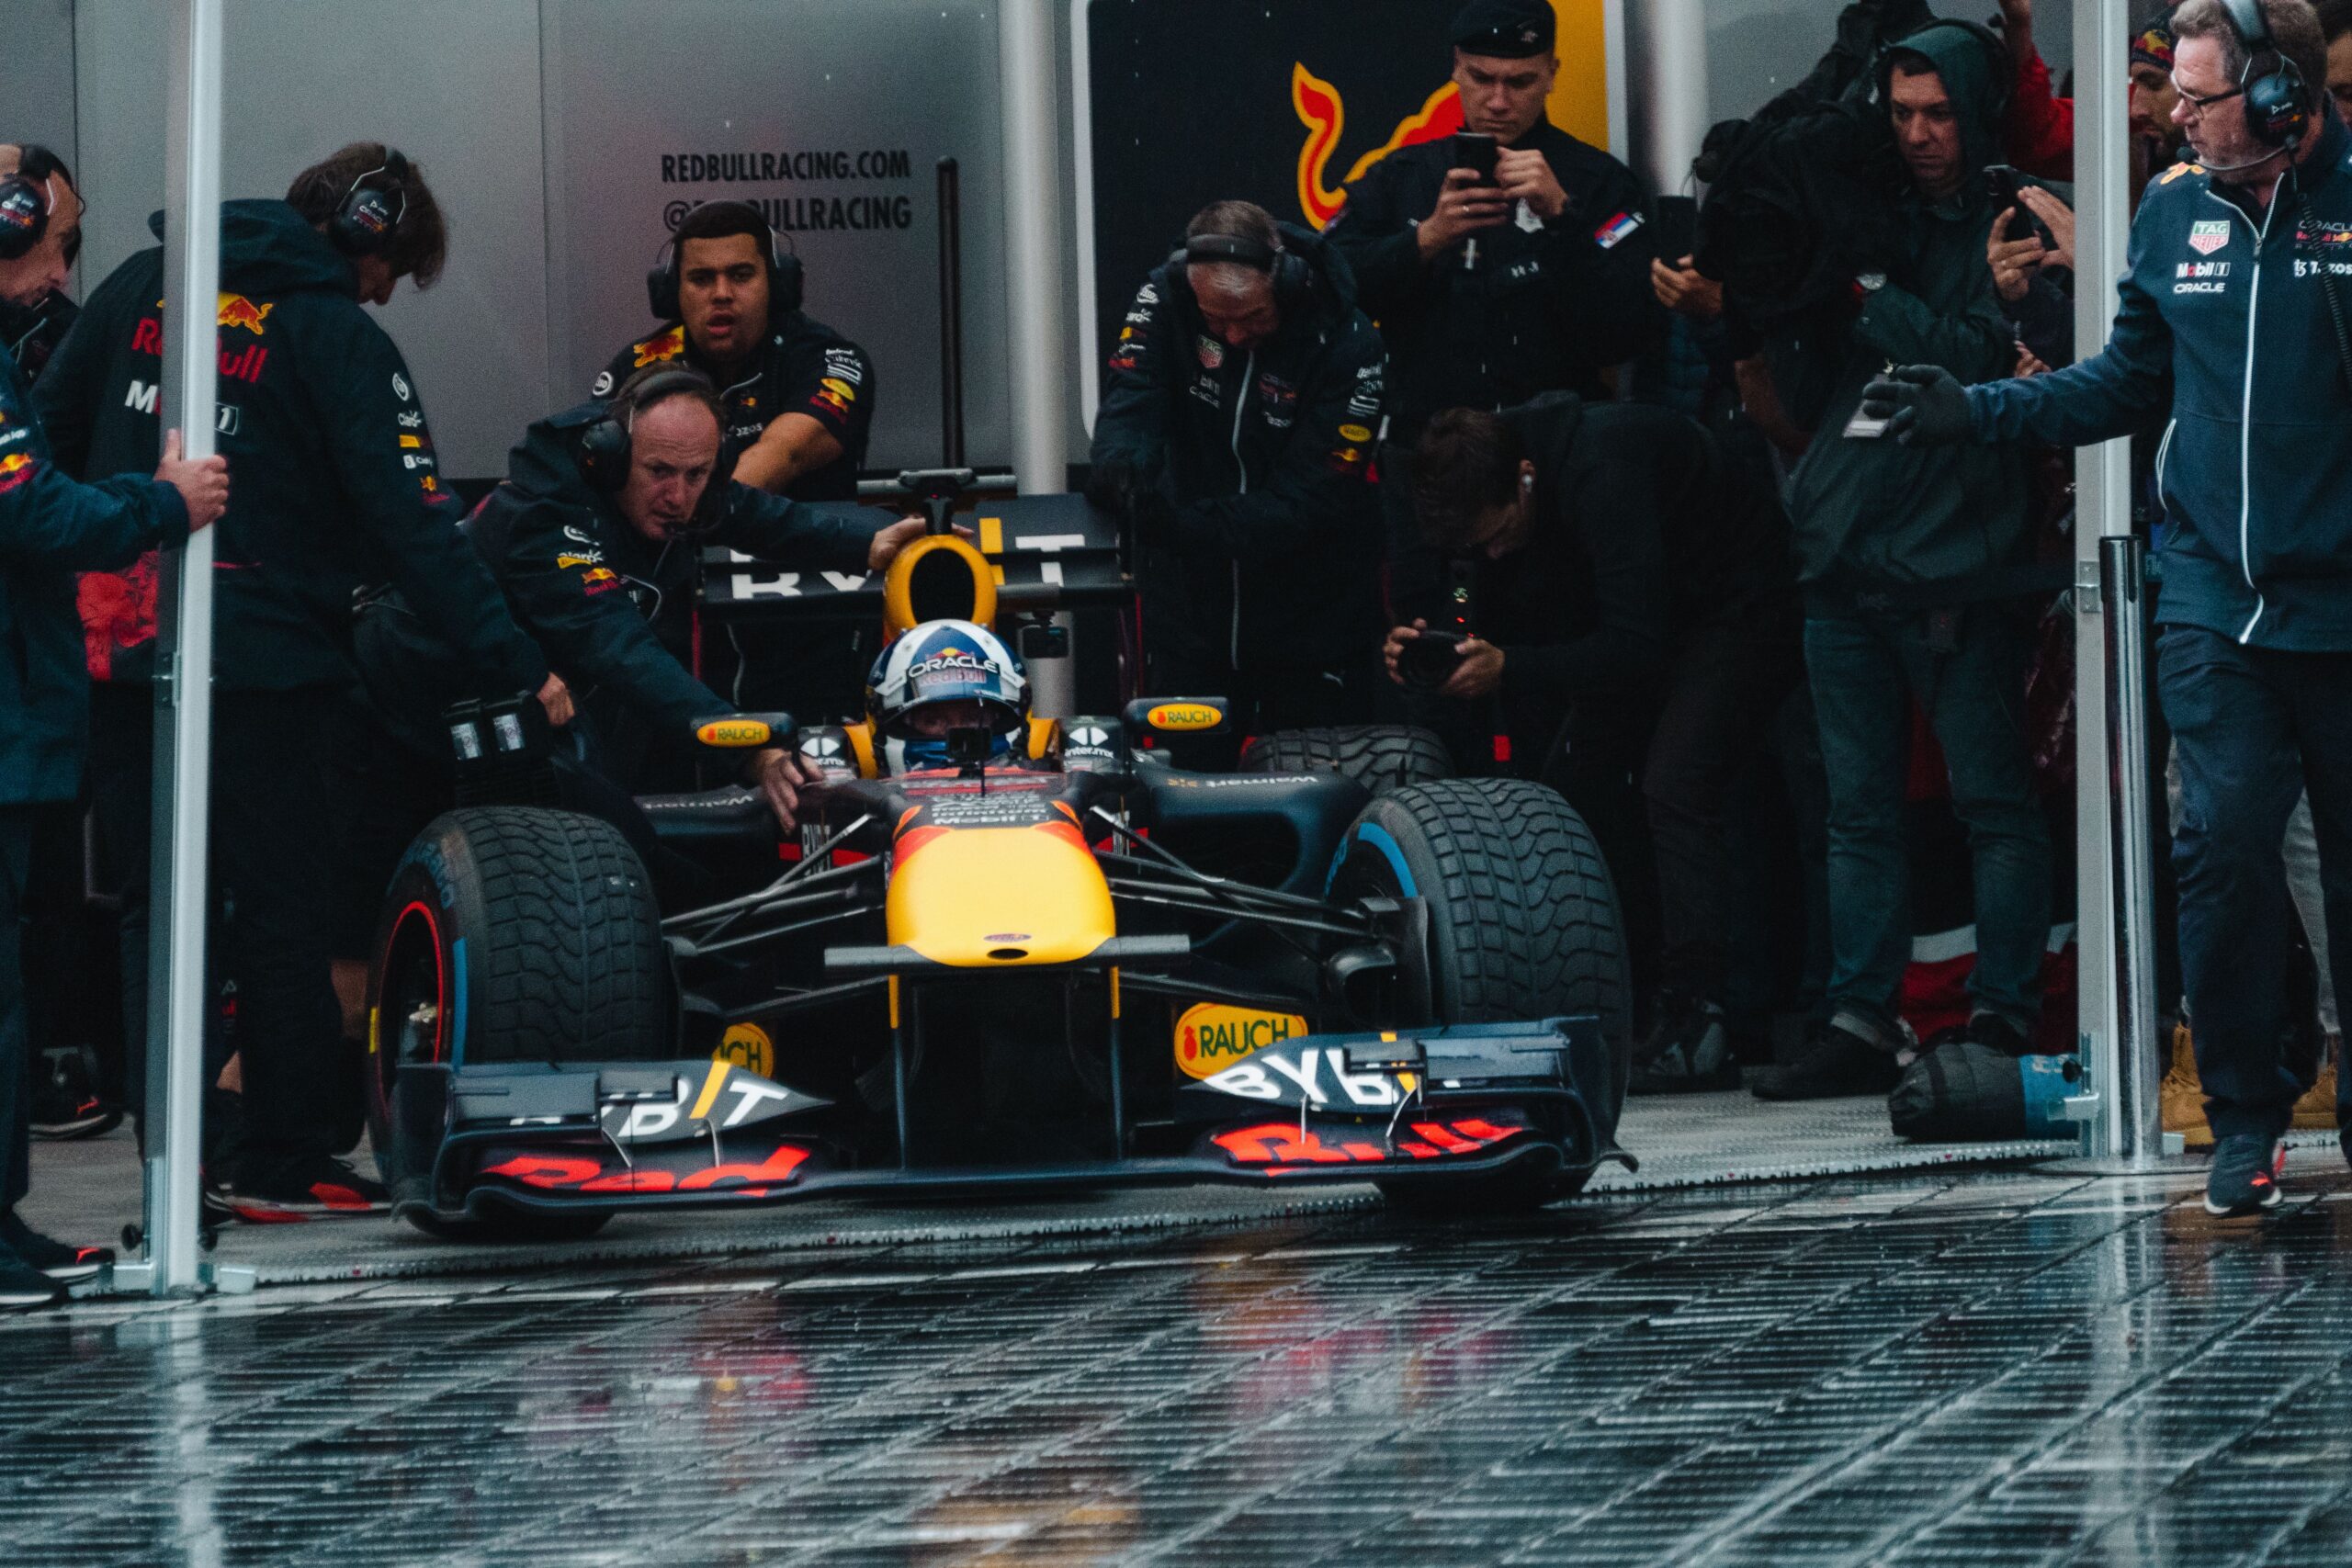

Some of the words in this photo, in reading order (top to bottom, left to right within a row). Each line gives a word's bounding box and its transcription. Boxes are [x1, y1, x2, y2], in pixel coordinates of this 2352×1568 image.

[662, 151, 910, 182] REDBULLRACING.COM
[663, 196, 911, 231] @ULLRACING
[2198, 223, 2227, 233] TAG
[2177, 263, 2214, 277] Mobil
[2173, 282, 2226, 293] ORACLE
[908, 656, 1000, 678] ORACLE
[1167, 711, 1213, 724] RAUCH
[717, 727, 762, 741] RAUCH
[1199, 1017, 1289, 1058] RAUCH
